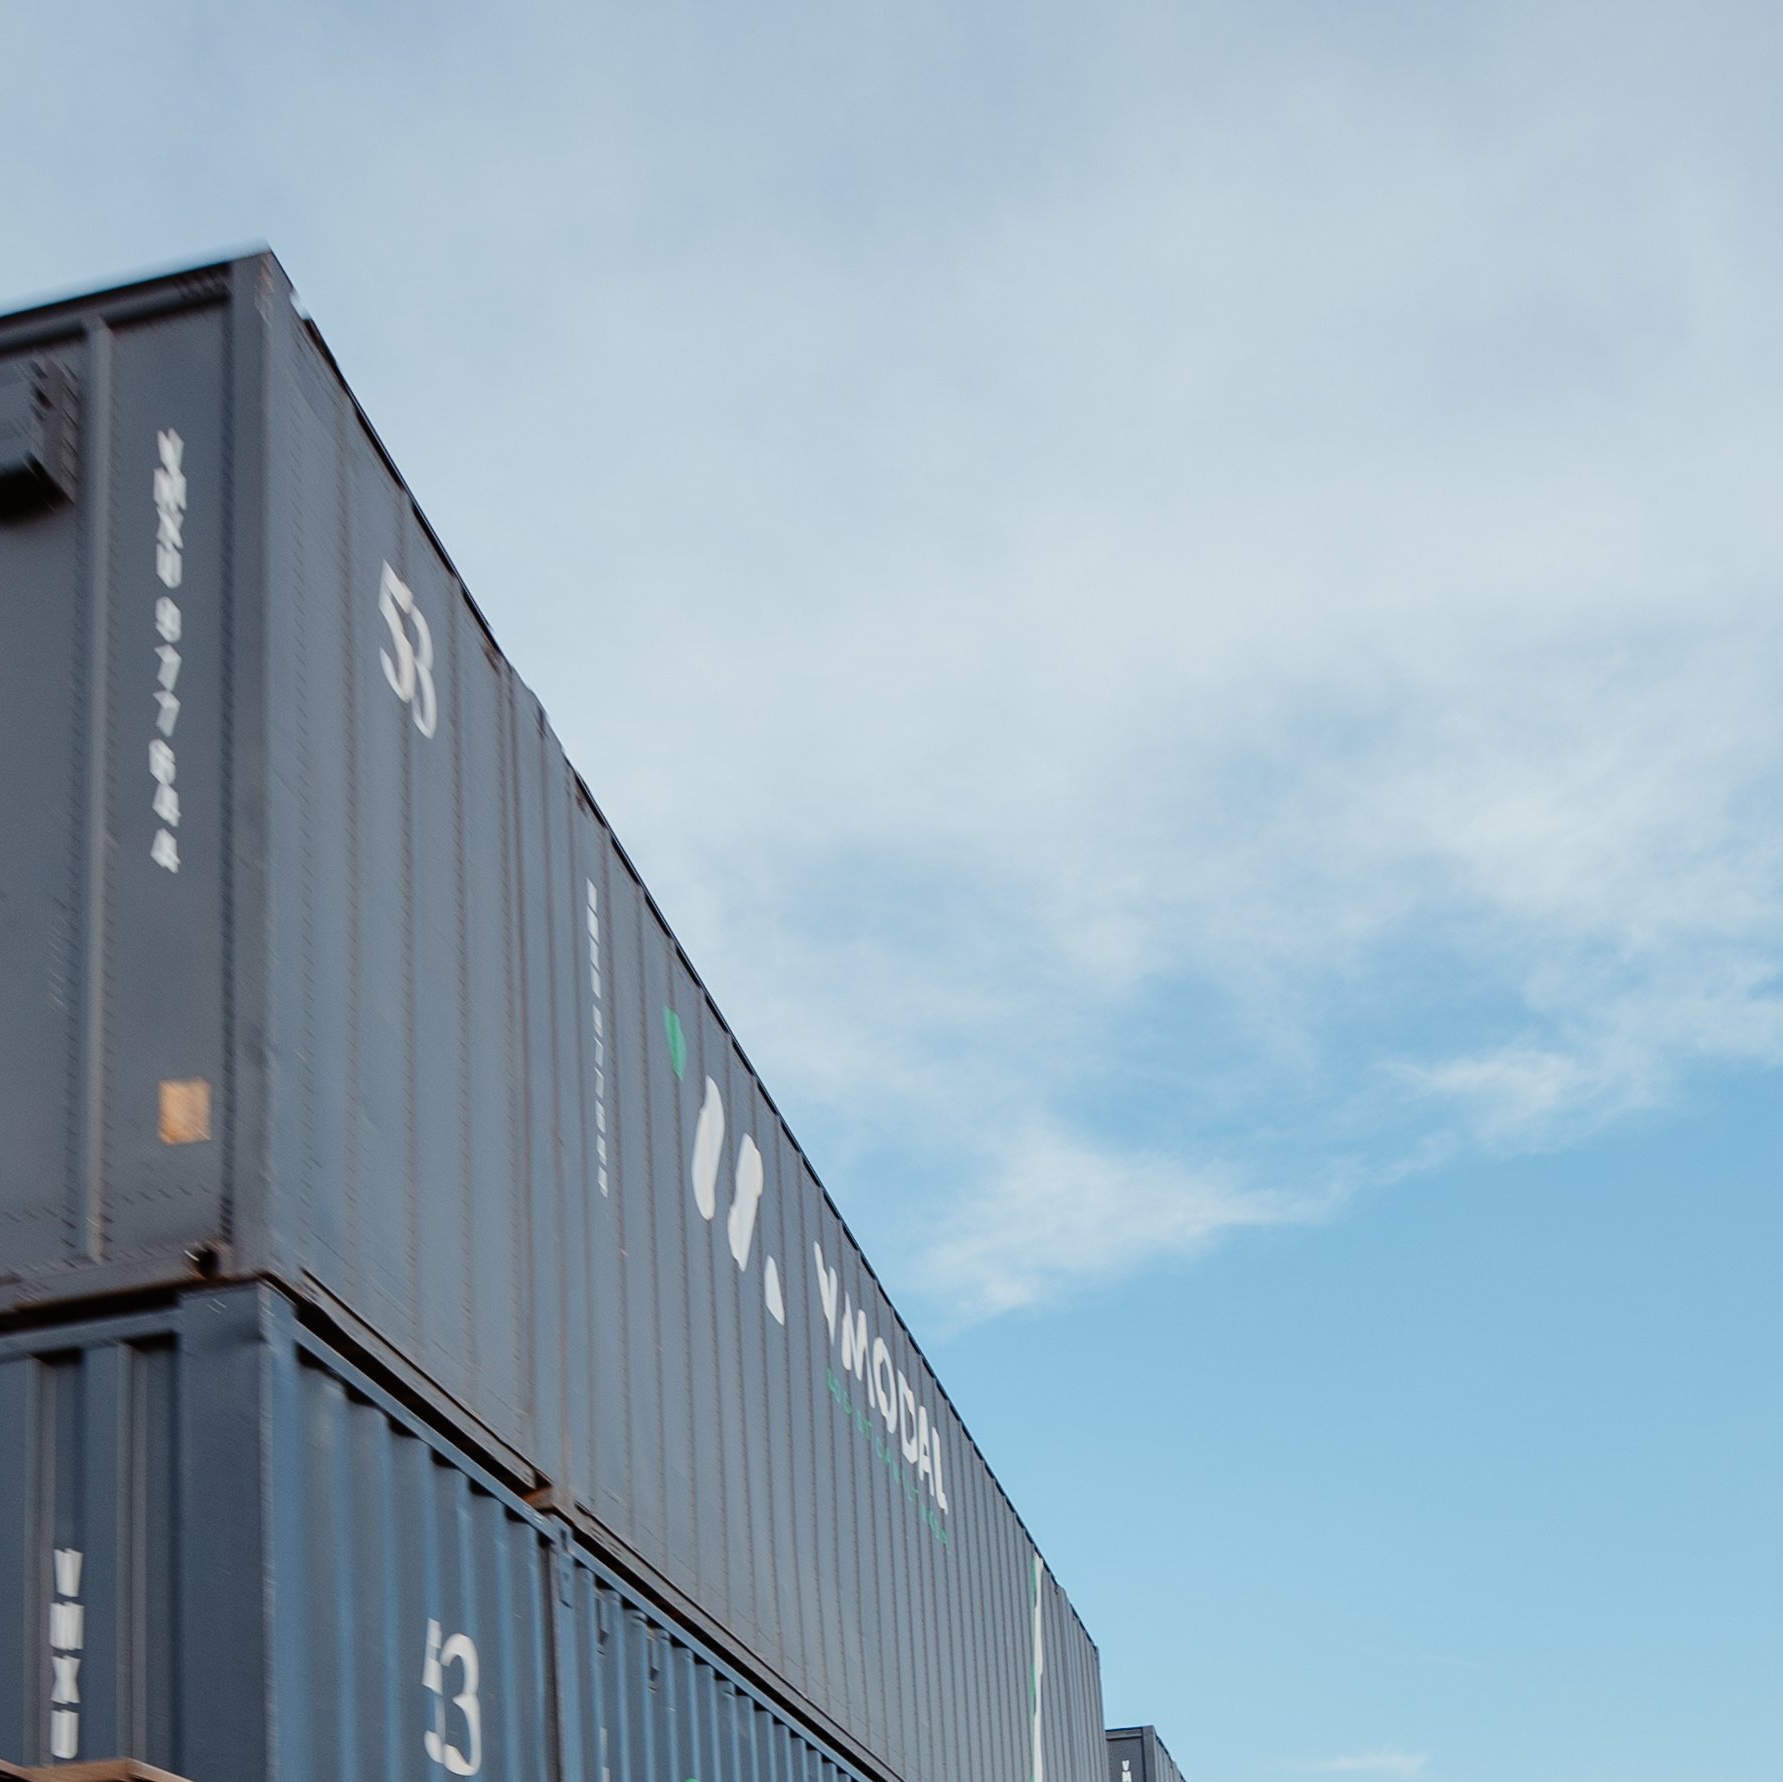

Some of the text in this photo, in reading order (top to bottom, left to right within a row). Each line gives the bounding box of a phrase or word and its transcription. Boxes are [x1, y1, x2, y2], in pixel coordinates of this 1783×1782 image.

[153, 427, 188, 589] VMXU
[378, 558, 438, 740] 53
[814, 1240, 949, 1516] VMODAL
[49, 1547, 86, 1760] VMXU
[421, 1616, 482, 1777] 53
